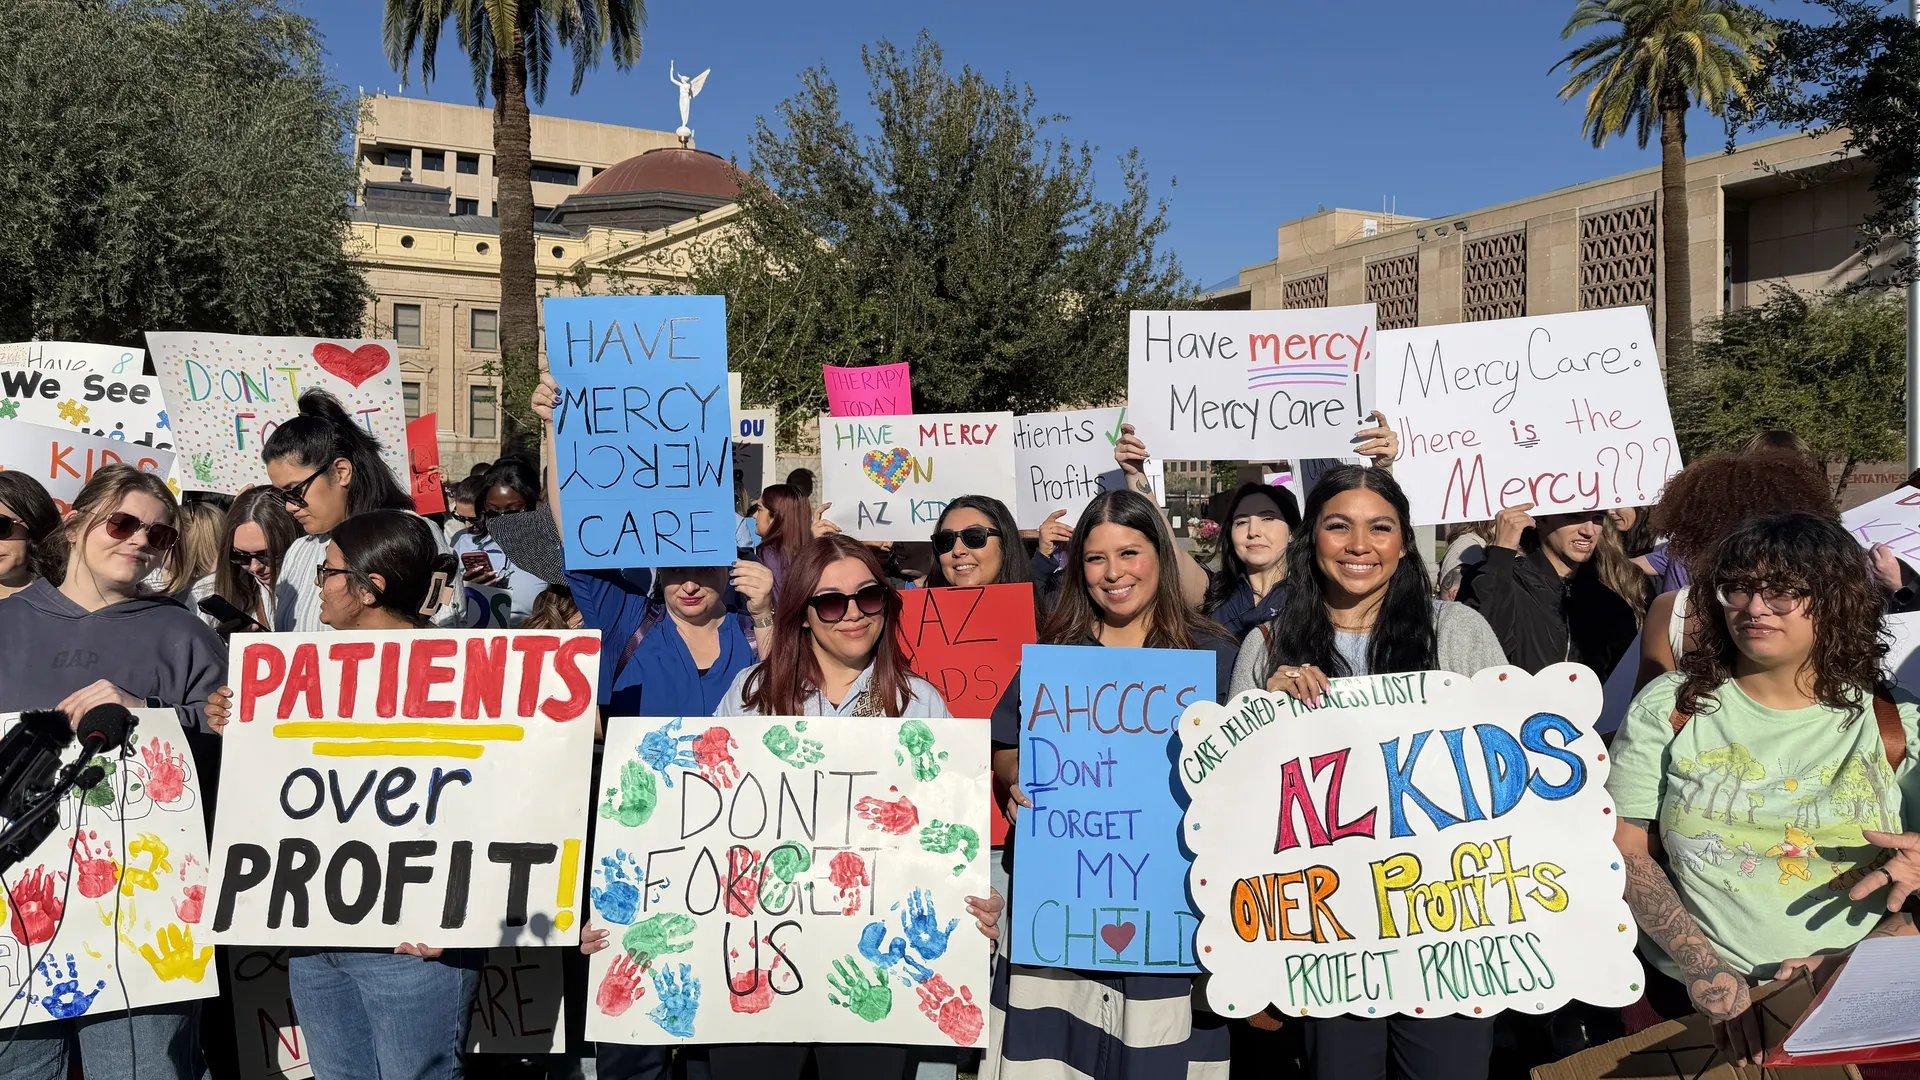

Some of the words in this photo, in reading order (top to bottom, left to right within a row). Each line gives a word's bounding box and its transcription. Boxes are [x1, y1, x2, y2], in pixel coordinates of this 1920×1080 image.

[565, 317, 701, 367] HAVE
[1146, 315, 1239, 363] Have
[1249, 326, 1371, 372] mercy,
[1, 370, 61, 399] We
[83, 374, 151, 405] See
[830, 368, 904, 391] THERAPY
[1398, 339, 1520, 414] Mercy
[1527, 327, 1642, 381] Care:
[557, 382, 721, 436] MERCY
[840, 396, 897, 417] TODAY
[1169, 384, 1260, 440] Mercy
[1509, 419, 1538, 442] is
[1565, 397, 1642, 434] the
[559, 436, 729, 492] MERCY
[835, 422, 894, 451] HAVE
[919, 422, 998, 447] MERCY
[1030, 464, 1107, 503] Profits
[578, 509, 719, 558] CARE
[857, 500, 893, 530] AZ
[916, 586, 998, 648] AZ
[239, 635, 601, 723] PATIENTS
[1027, 680, 1198, 735] AHCCCS
[1182, 734, 1228, 785] CARE
[1220, 696, 1276, 748] DELAYED
[1371, 672, 1427, 706] LOST!
[280, 766, 473, 827] over
[1273, 747, 1378, 855] AZ
[1379, 711, 1588, 839] KIDS
[1029, 786, 1143, 841] FORGET
[212, 837, 582, 934] PROFIT!
[642, 844, 899, 917] FORGET
[1077, 848, 1150, 901] MY
[1230, 864, 1355, 943] OVER
[1368, 834, 1570, 940] Profits
[722, 919, 804, 997] US
[1031, 899, 1200, 968] CHILD
[1285, 948, 1400, 1007] PROTECT
[1417, 931, 1556, 1003] PROGRESS
